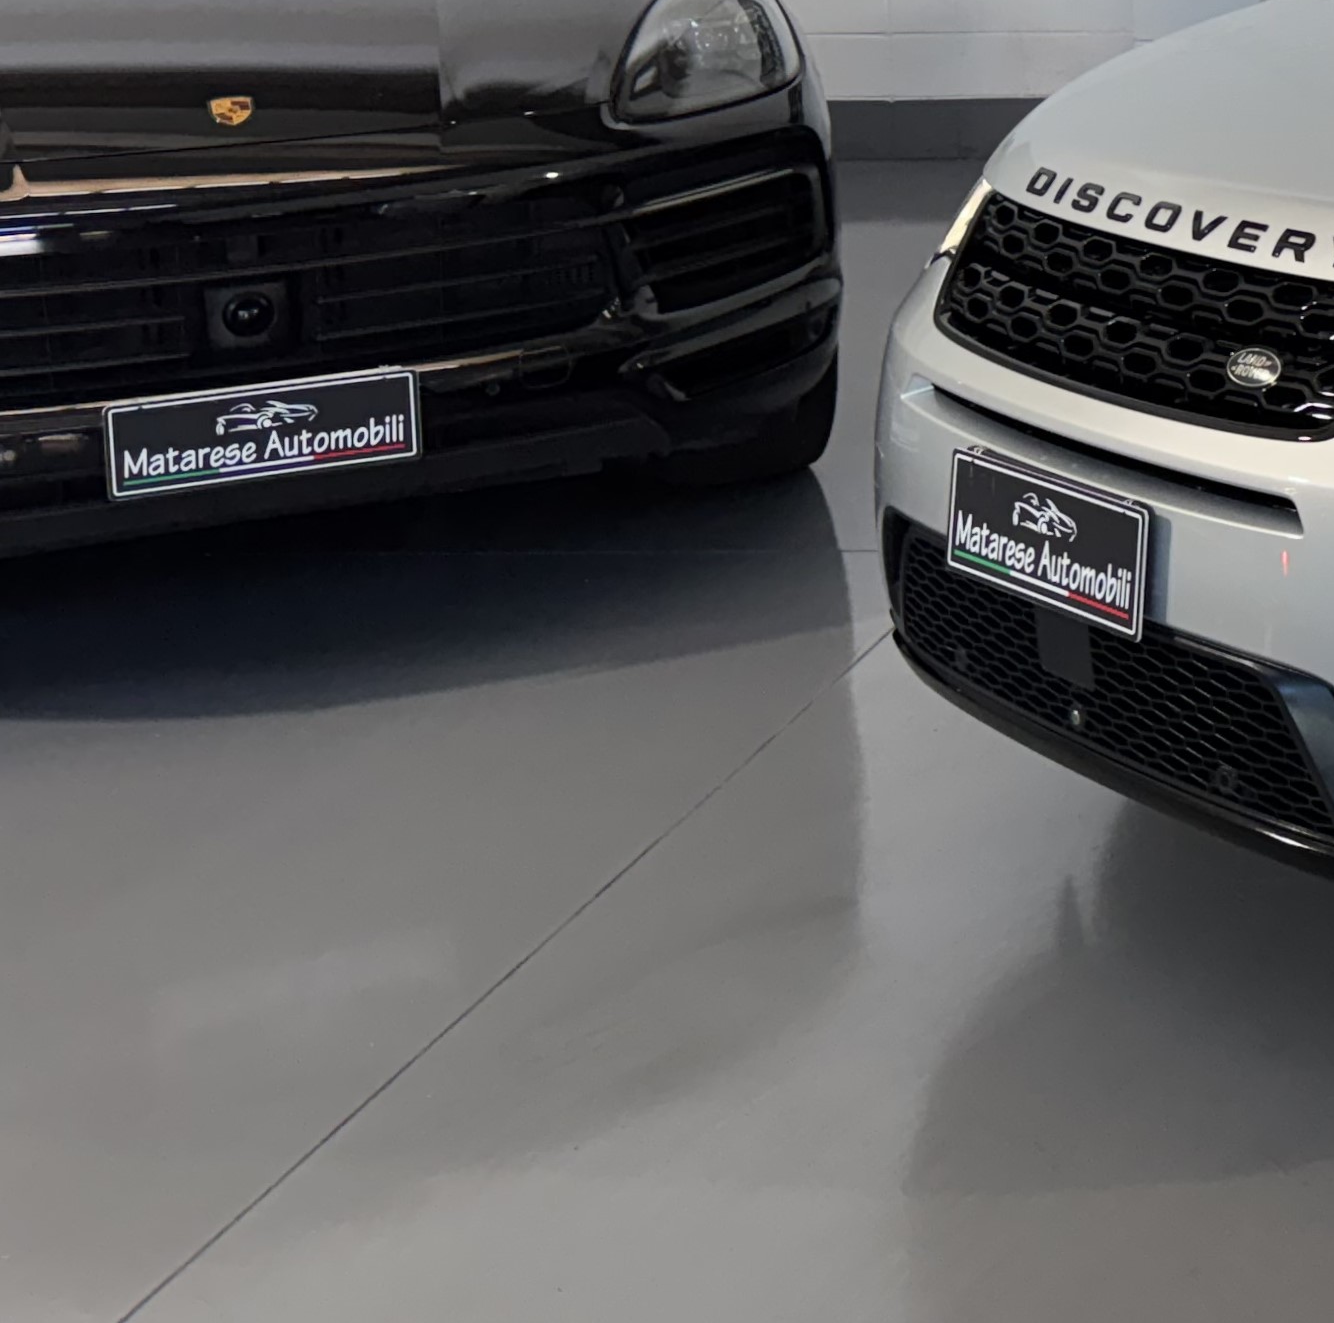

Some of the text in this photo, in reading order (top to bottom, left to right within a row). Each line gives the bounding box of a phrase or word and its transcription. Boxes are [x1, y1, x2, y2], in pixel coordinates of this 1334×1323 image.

[123, 413, 405, 478] Matarese Automobili
[955, 509, 1132, 610] Matarese Automobili
